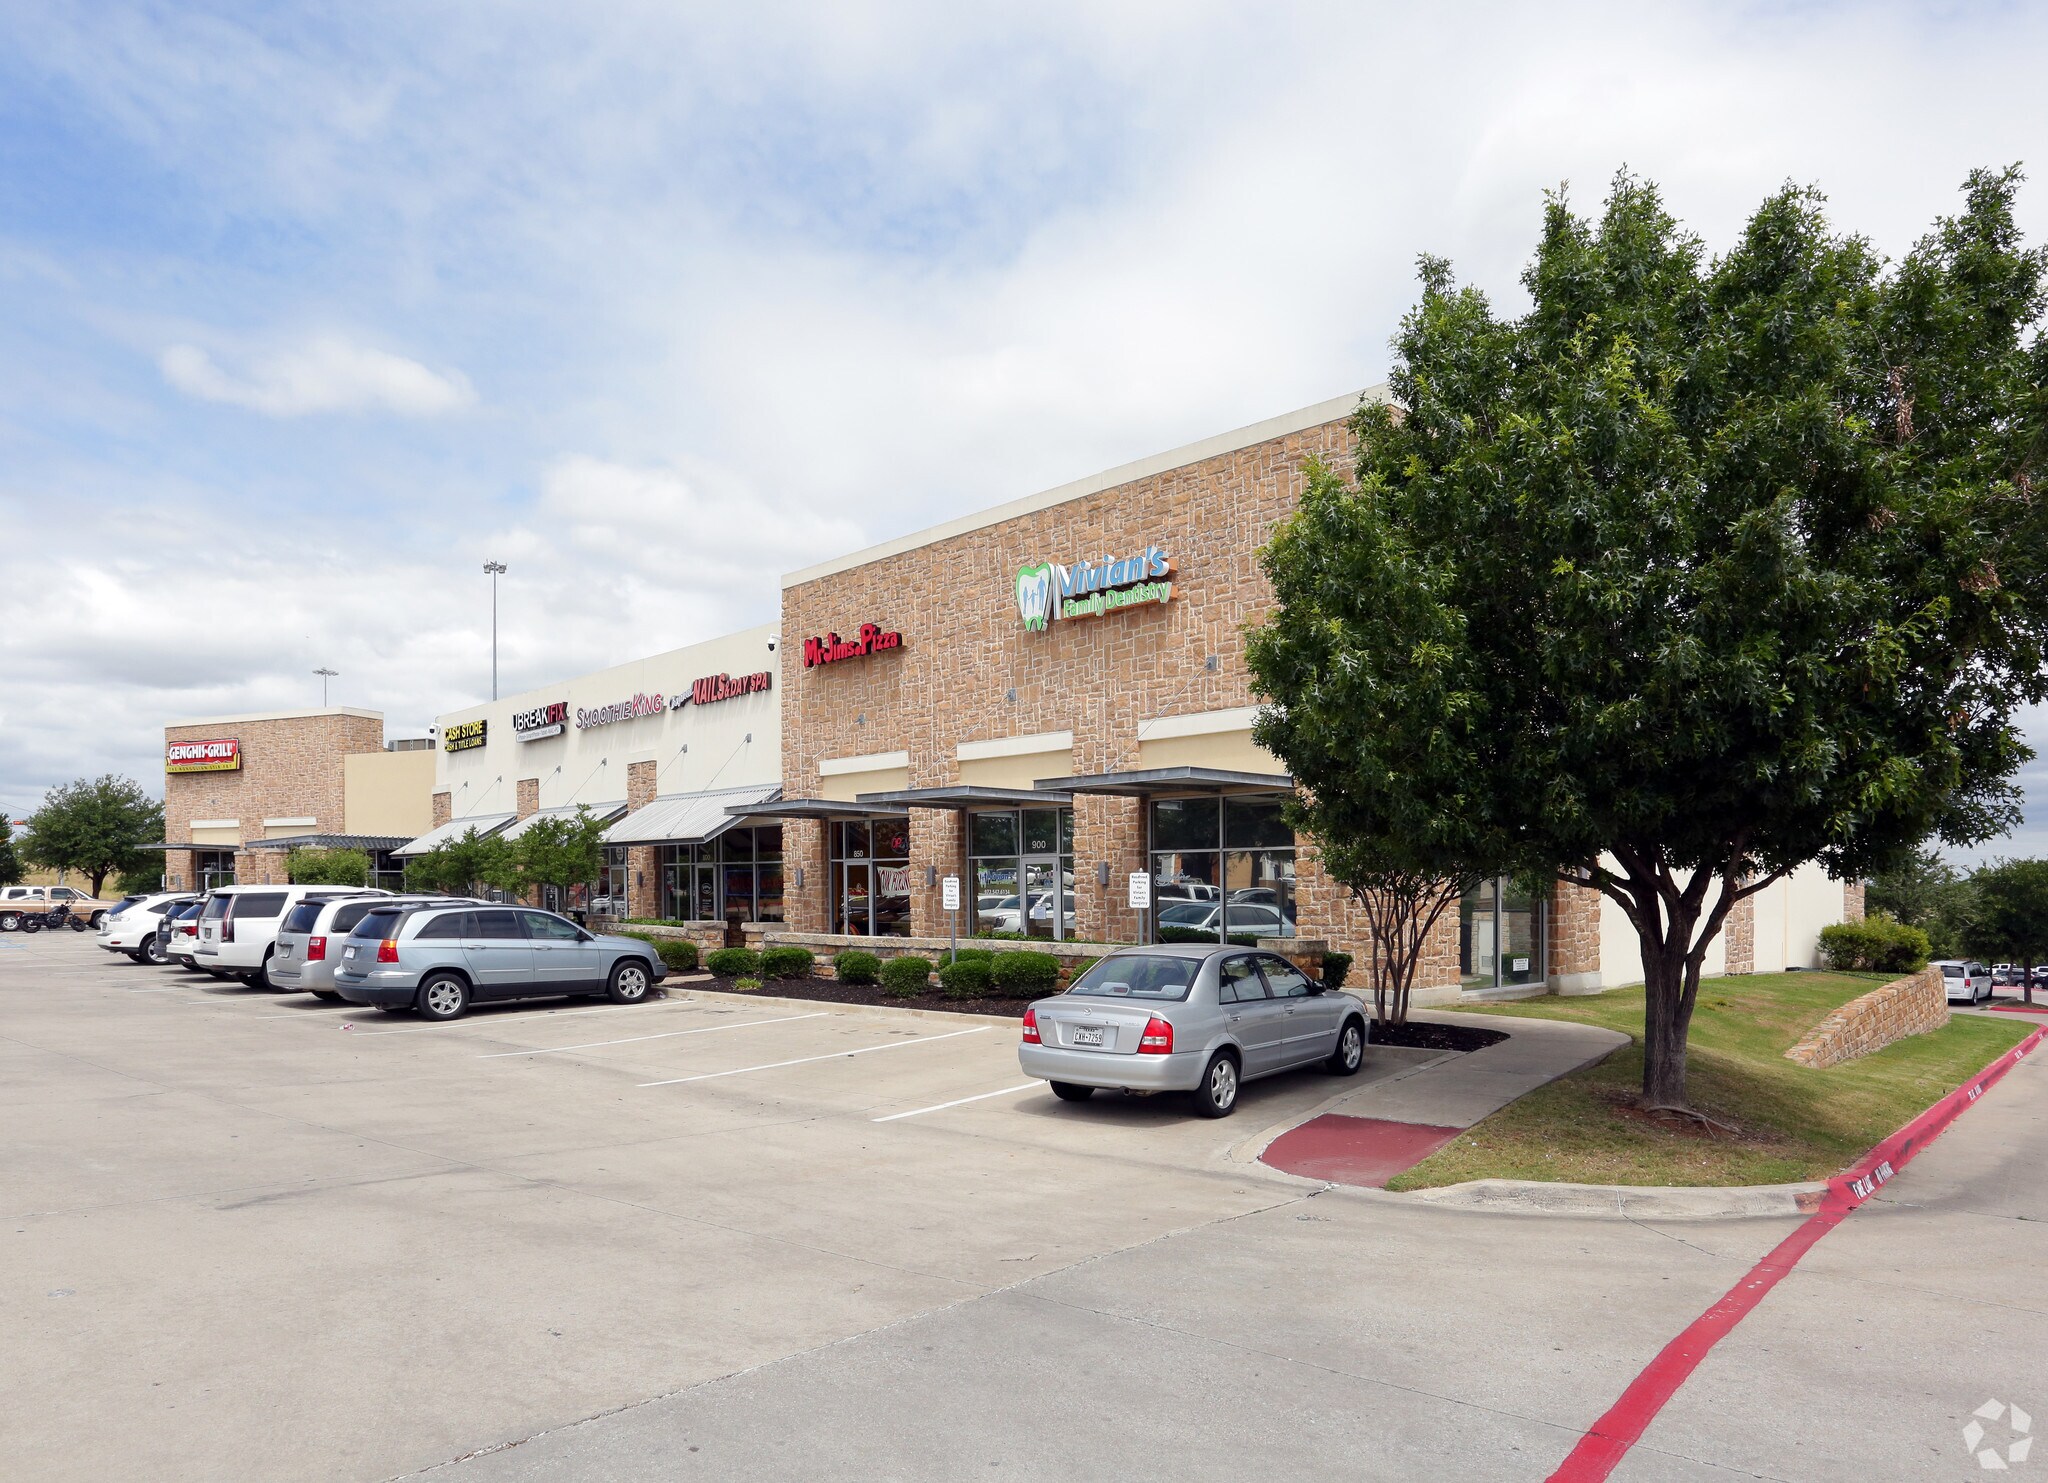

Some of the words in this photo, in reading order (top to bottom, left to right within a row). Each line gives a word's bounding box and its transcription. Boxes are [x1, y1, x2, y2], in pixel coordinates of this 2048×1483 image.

[1060, 546, 1169, 597] Vivian's
[1064, 591, 1106, 618] Family
[1105, 581, 1171, 611] Dentistry
[693, 673, 727, 704] NAILS
[730, 677, 750, 696] DAY
[750, 672, 770, 692] SPA
[445, 726, 460, 742] CASH
[461, 720, 483, 738] STORE
[469, 736, 482, 747] LOANS
[853, 850, 864, 858] 850
[1032, 840, 1046, 849] 900
